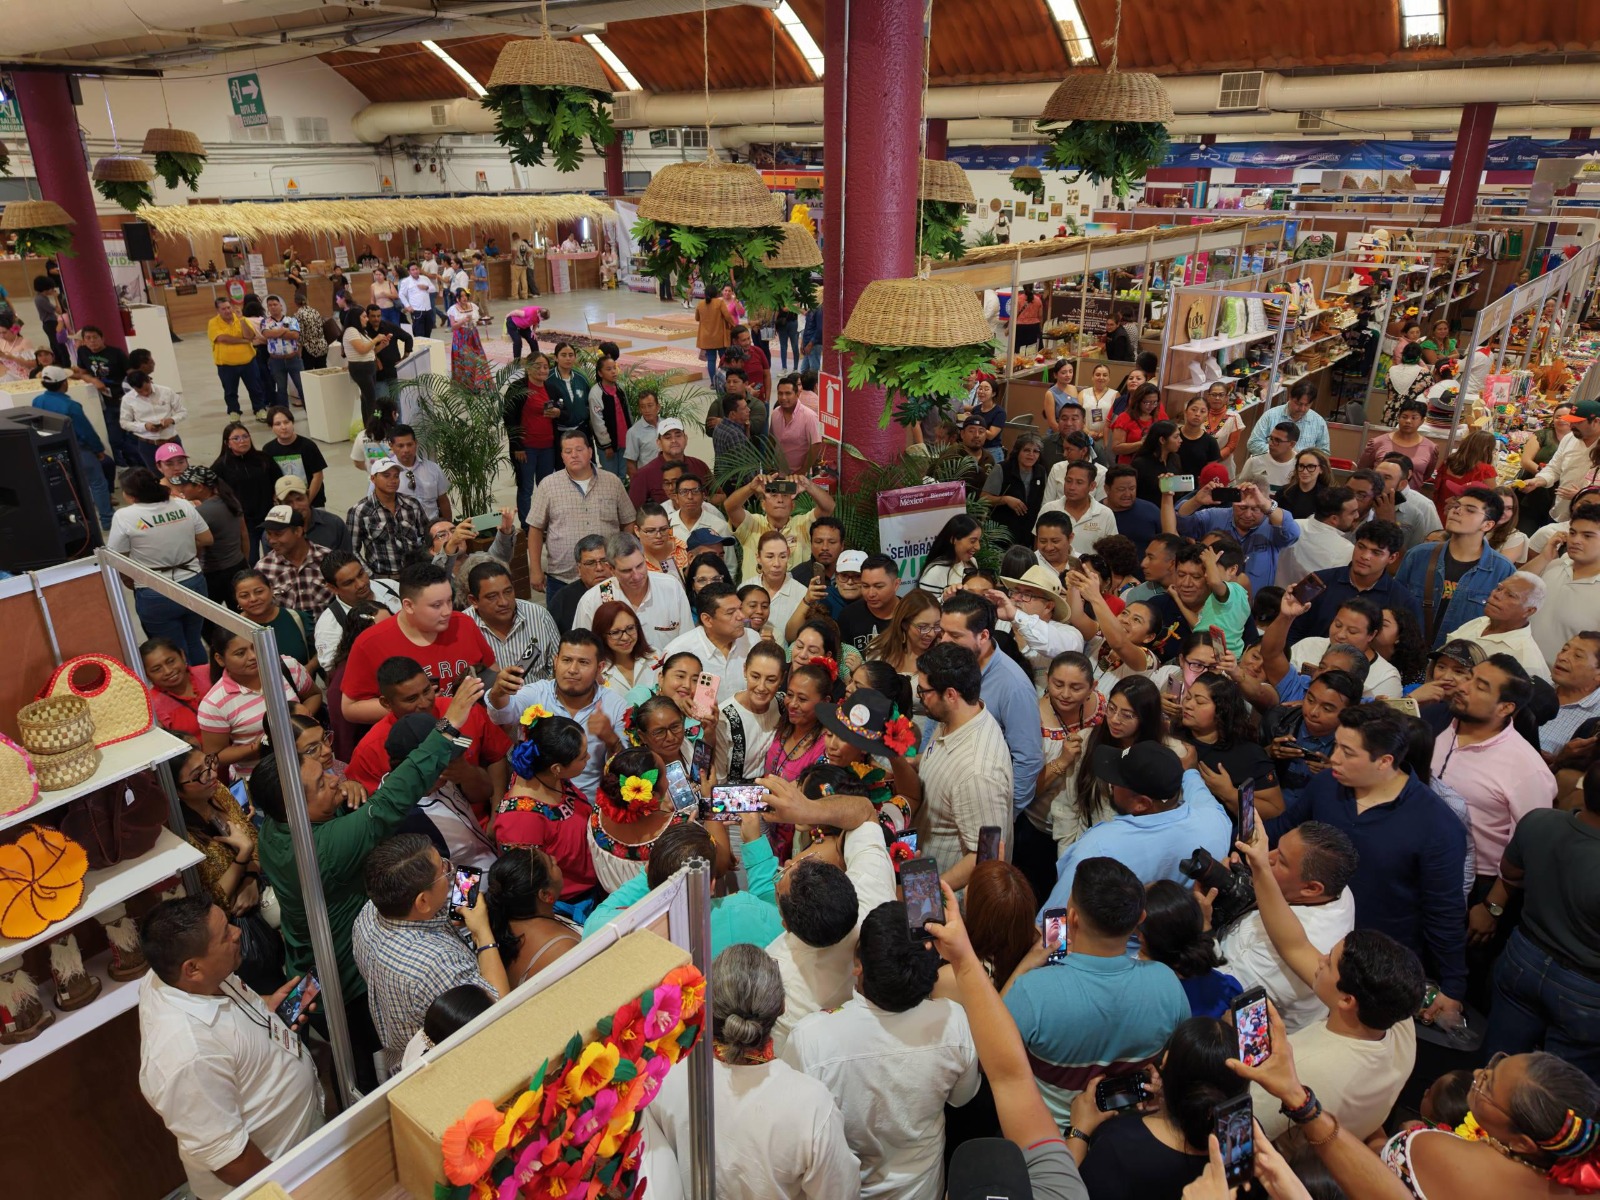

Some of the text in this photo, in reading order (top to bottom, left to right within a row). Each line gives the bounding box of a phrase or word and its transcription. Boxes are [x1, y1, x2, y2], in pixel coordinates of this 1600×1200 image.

[240, 103, 257, 114] RUTA DE
[1189, 153, 1221, 161] BYD
[900, 498, 924, 506] México
[152, 508, 187, 525] LA ISLA
[890, 542, 934, 560] SEMBRA
[423, 659, 468, 679] ERO
